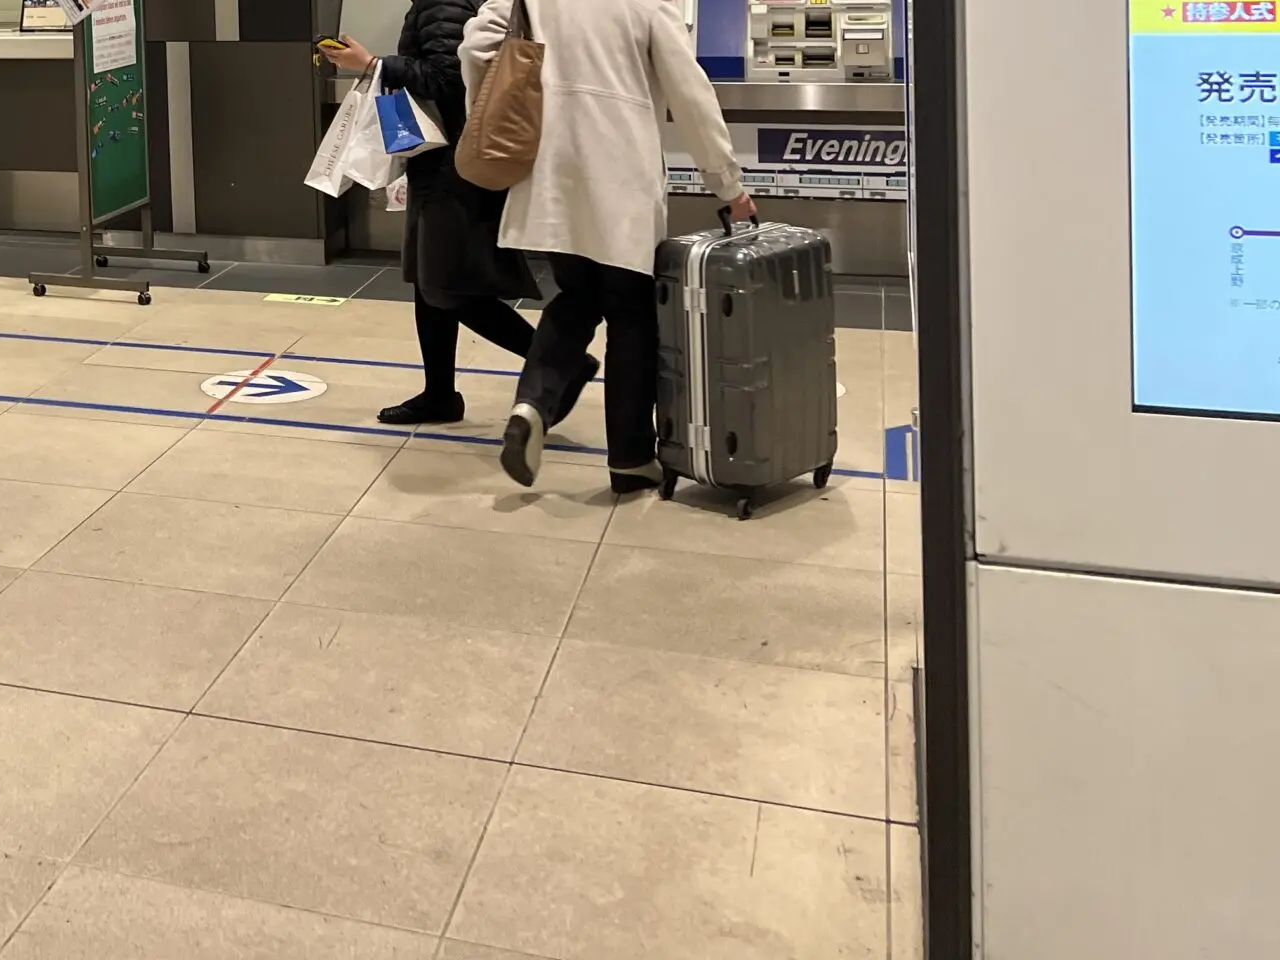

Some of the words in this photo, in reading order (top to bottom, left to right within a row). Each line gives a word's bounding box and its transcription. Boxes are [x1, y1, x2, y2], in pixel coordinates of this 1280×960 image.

[1183, 1, 1276, 22] 持参人式
[1195, 70, 1280, 104] 発売
[324, 144, 340, 177] CHEESE
[338, 103, 354, 140] GARDEN
[782, 132, 907, 166] Evening
